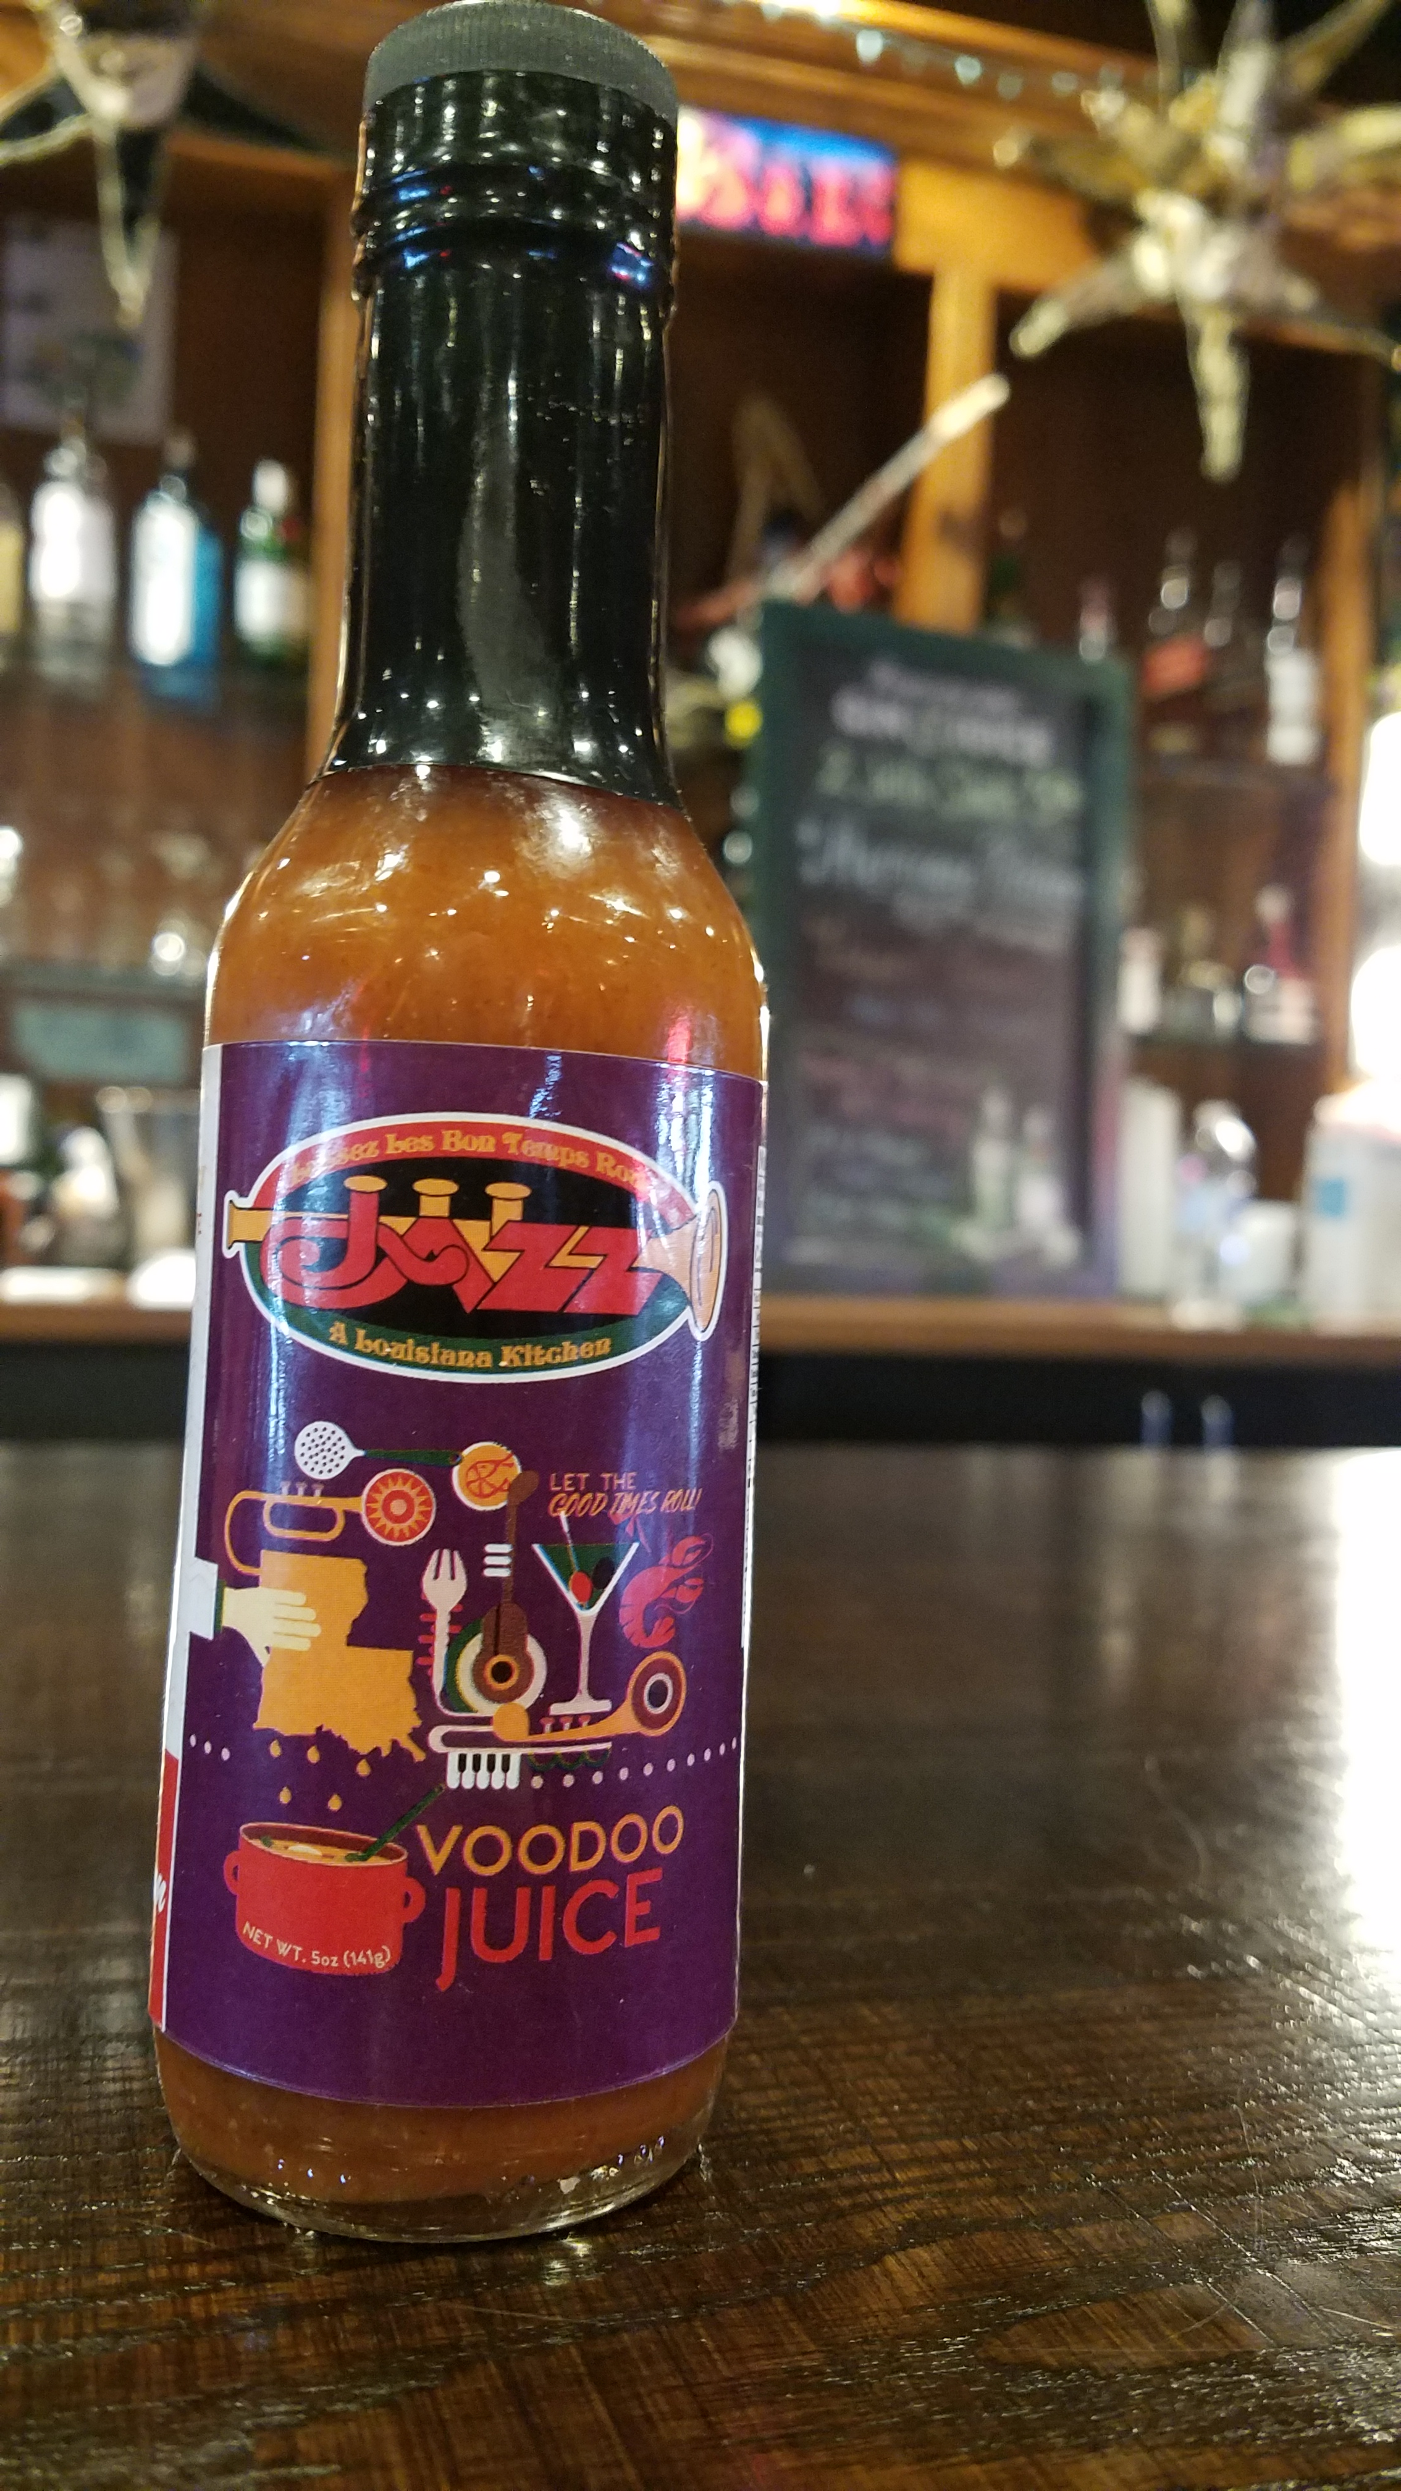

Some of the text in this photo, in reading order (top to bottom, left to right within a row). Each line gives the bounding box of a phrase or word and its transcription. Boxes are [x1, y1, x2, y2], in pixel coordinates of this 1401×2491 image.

[384, 1133, 435, 1154] Les
[441, 1129, 495, 1152] Bon
[502, 1132, 589, 1168] Temps
[329, 1321, 612, 1368] A Louisiana Kitchen
[548, 1492, 607, 1517] GOOD
[607, 1490, 662, 1514] TIMES
[550, 1472, 637, 1491] LET THE
[416, 1805, 684, 1875] VOODOO
[243, 1921, 391, 1968] NET WT. 5oz (141g)
[436, 1868, 663, 1992] JUICE
